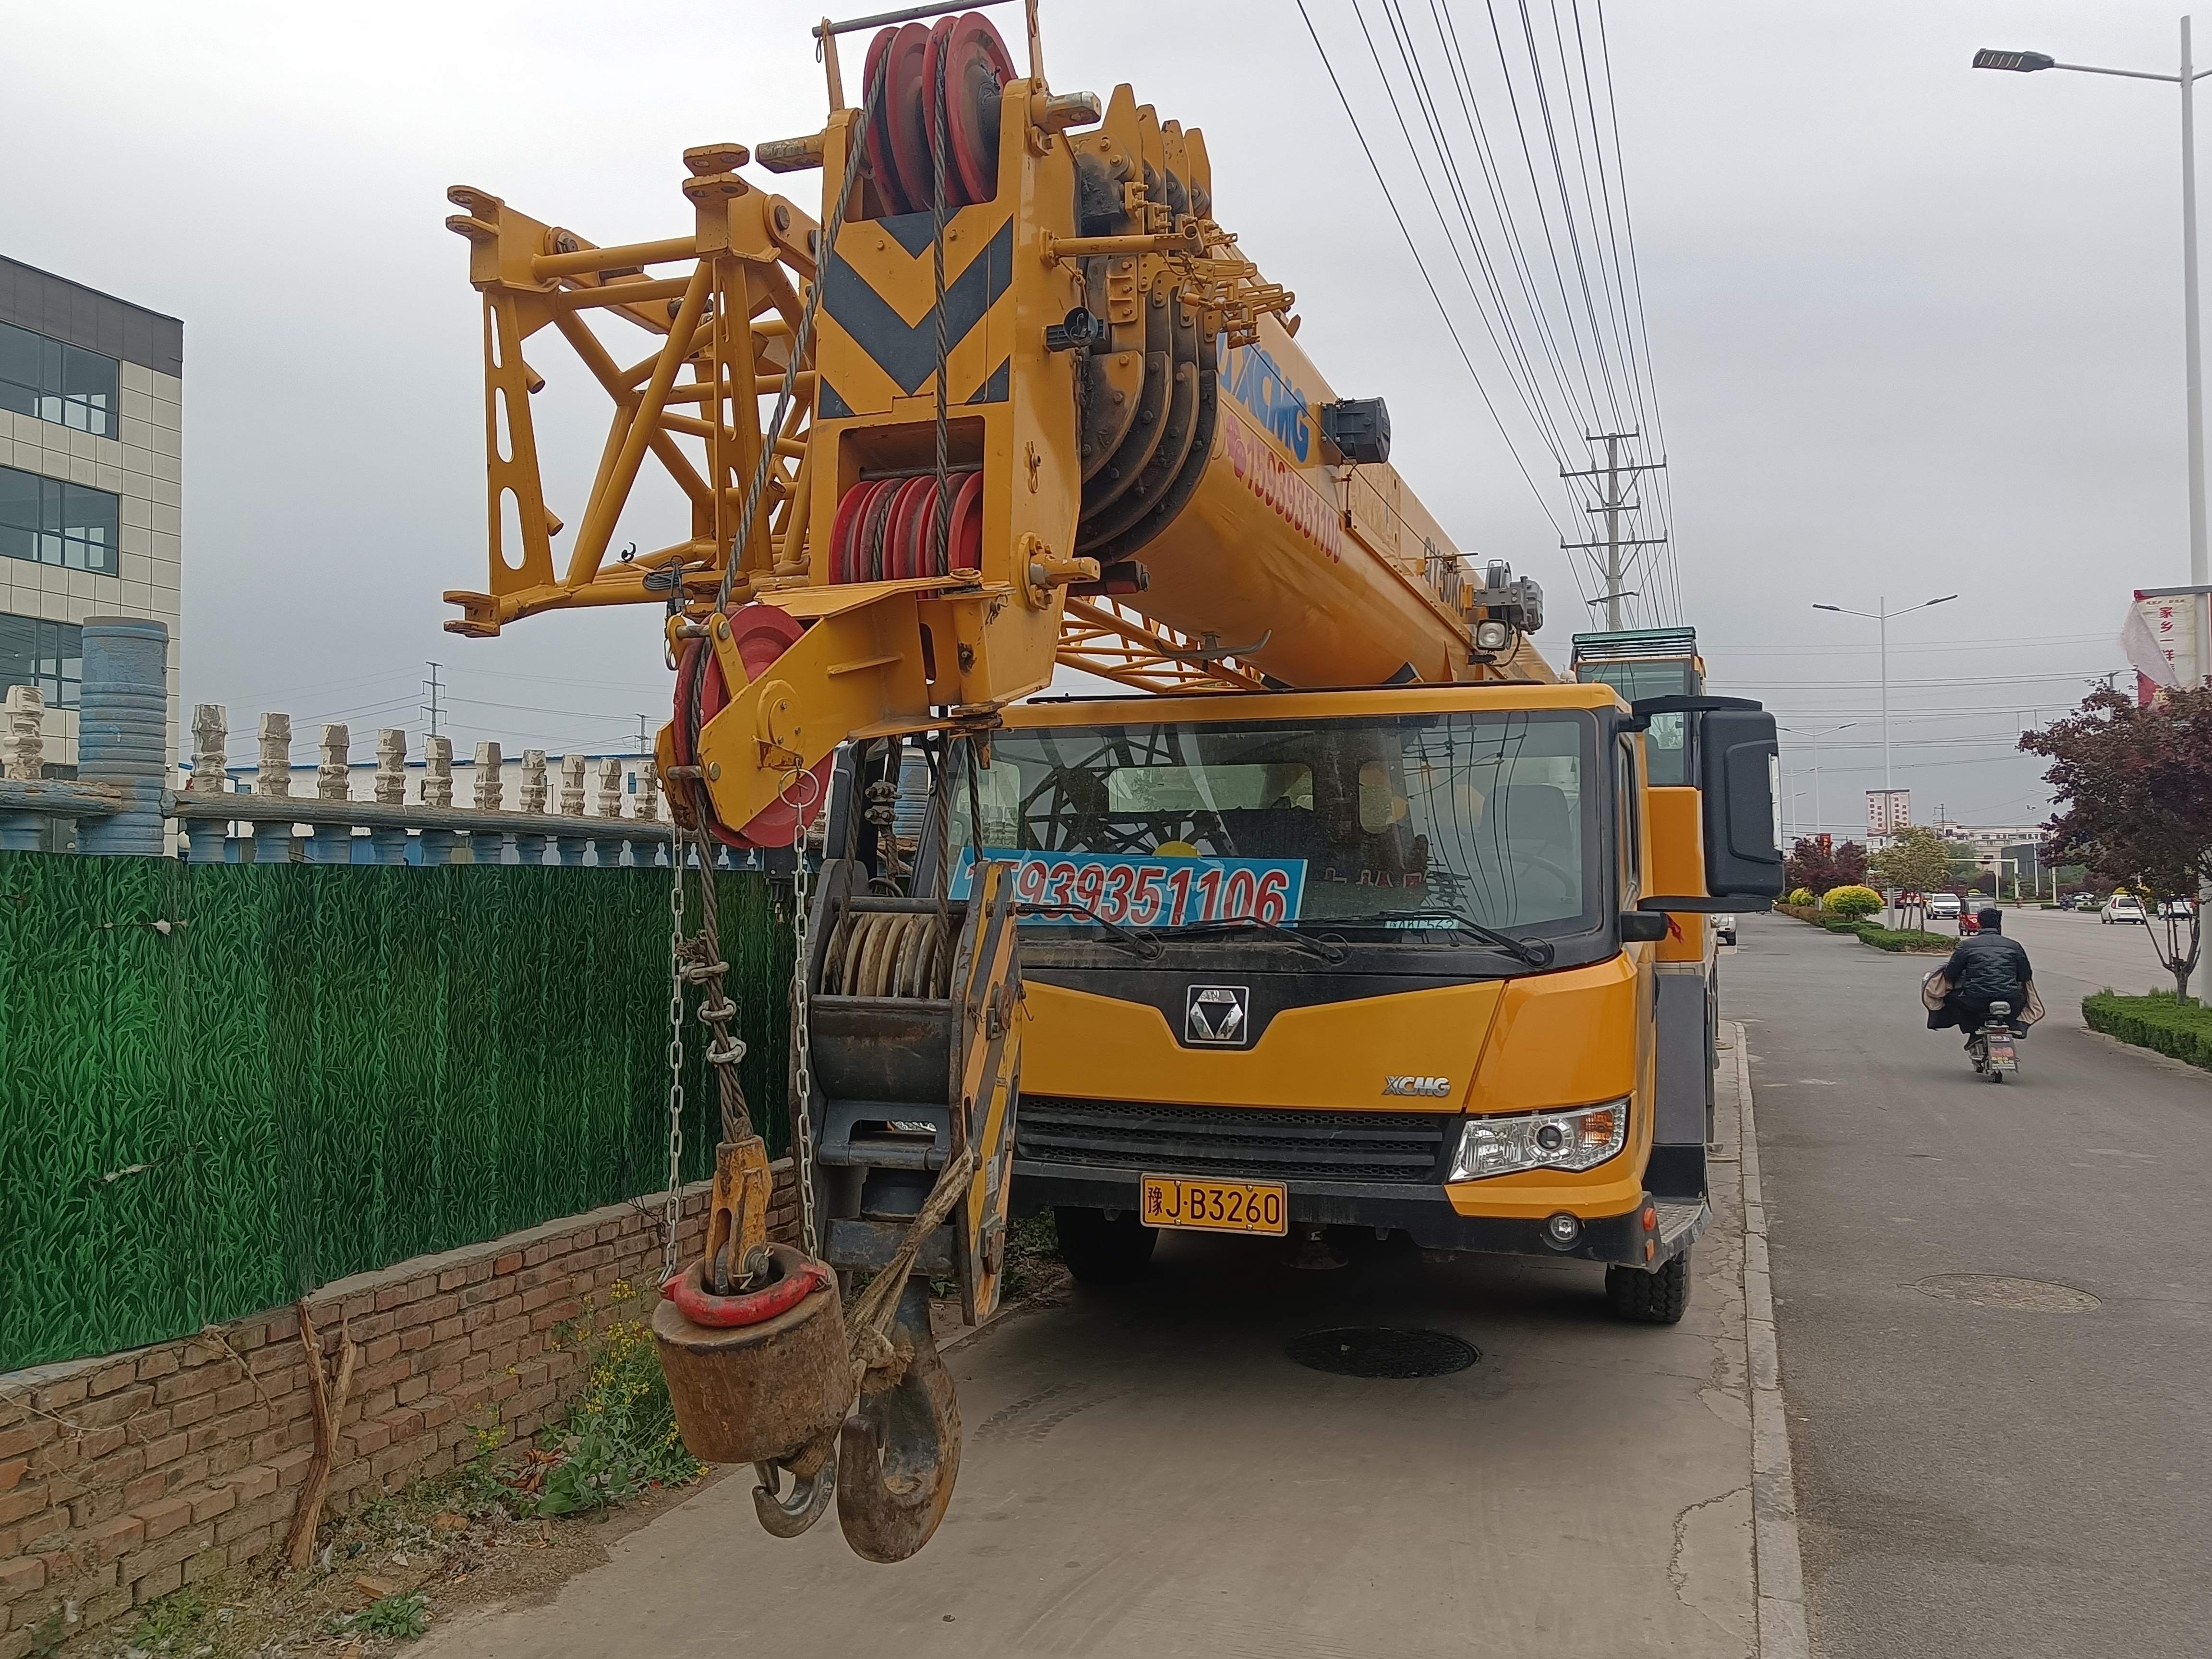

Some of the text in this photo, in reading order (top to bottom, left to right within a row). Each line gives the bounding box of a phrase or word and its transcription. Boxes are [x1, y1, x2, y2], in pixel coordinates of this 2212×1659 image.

[1232, 344, 1310, 464] XCMG
[1246, 435, 1343, 565] 15939351106
[966, 859, 1288, 928] 939351106
[1382, 1076, 1451, 1097] XCMG
